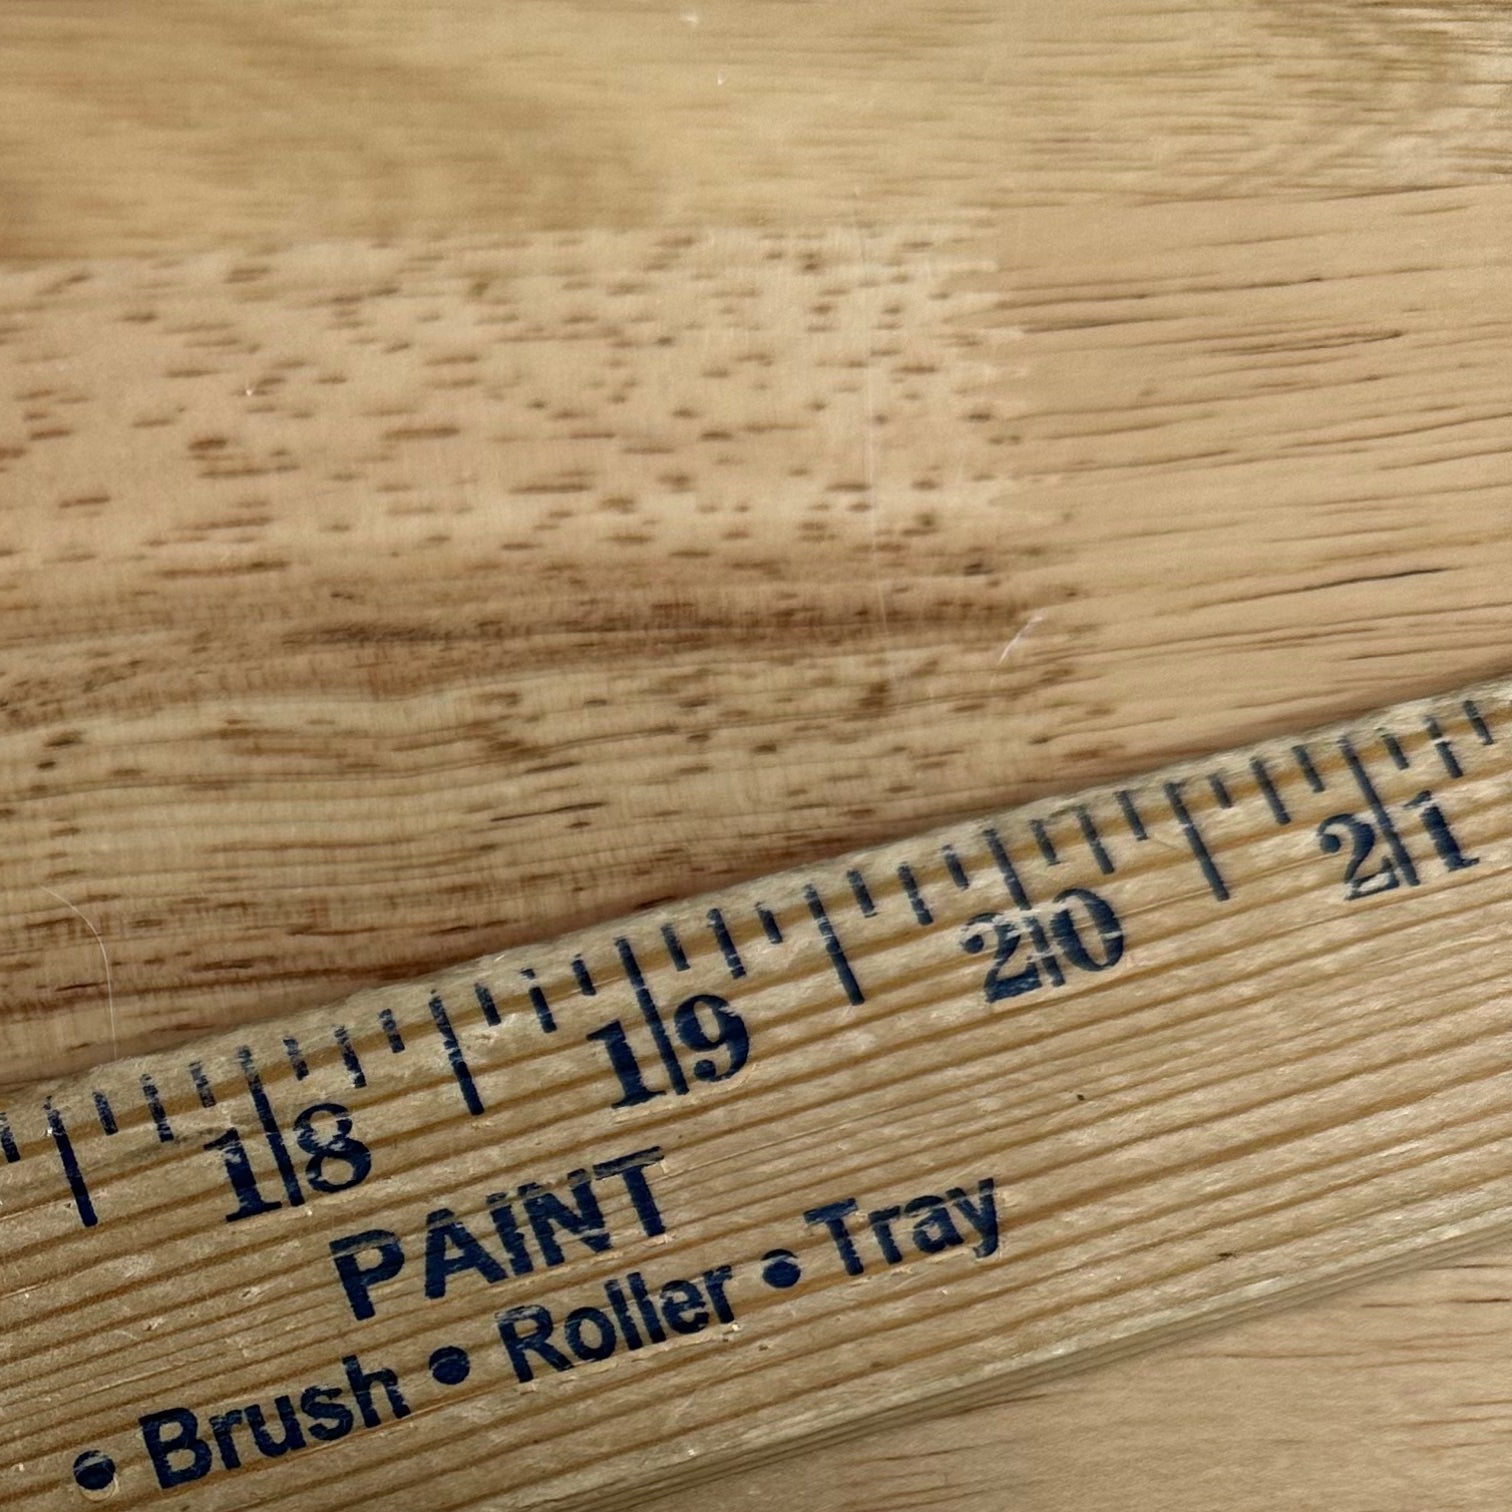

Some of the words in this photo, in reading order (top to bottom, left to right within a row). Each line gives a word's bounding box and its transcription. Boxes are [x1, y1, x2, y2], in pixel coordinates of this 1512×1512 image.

[202, 1101, 372, 1224] 18
[586, 993, 752, 1109] 19
[959, 887, 1125, 1003] 20
[1317, 789, 1480, 901] 21
[138, 1353, 412, 1490] Brush
[494, 1264, 734, 1384] Roller
[803, 1177, 1001, 1259] Tray
[328, 1145, 667, 1322] PAINT
